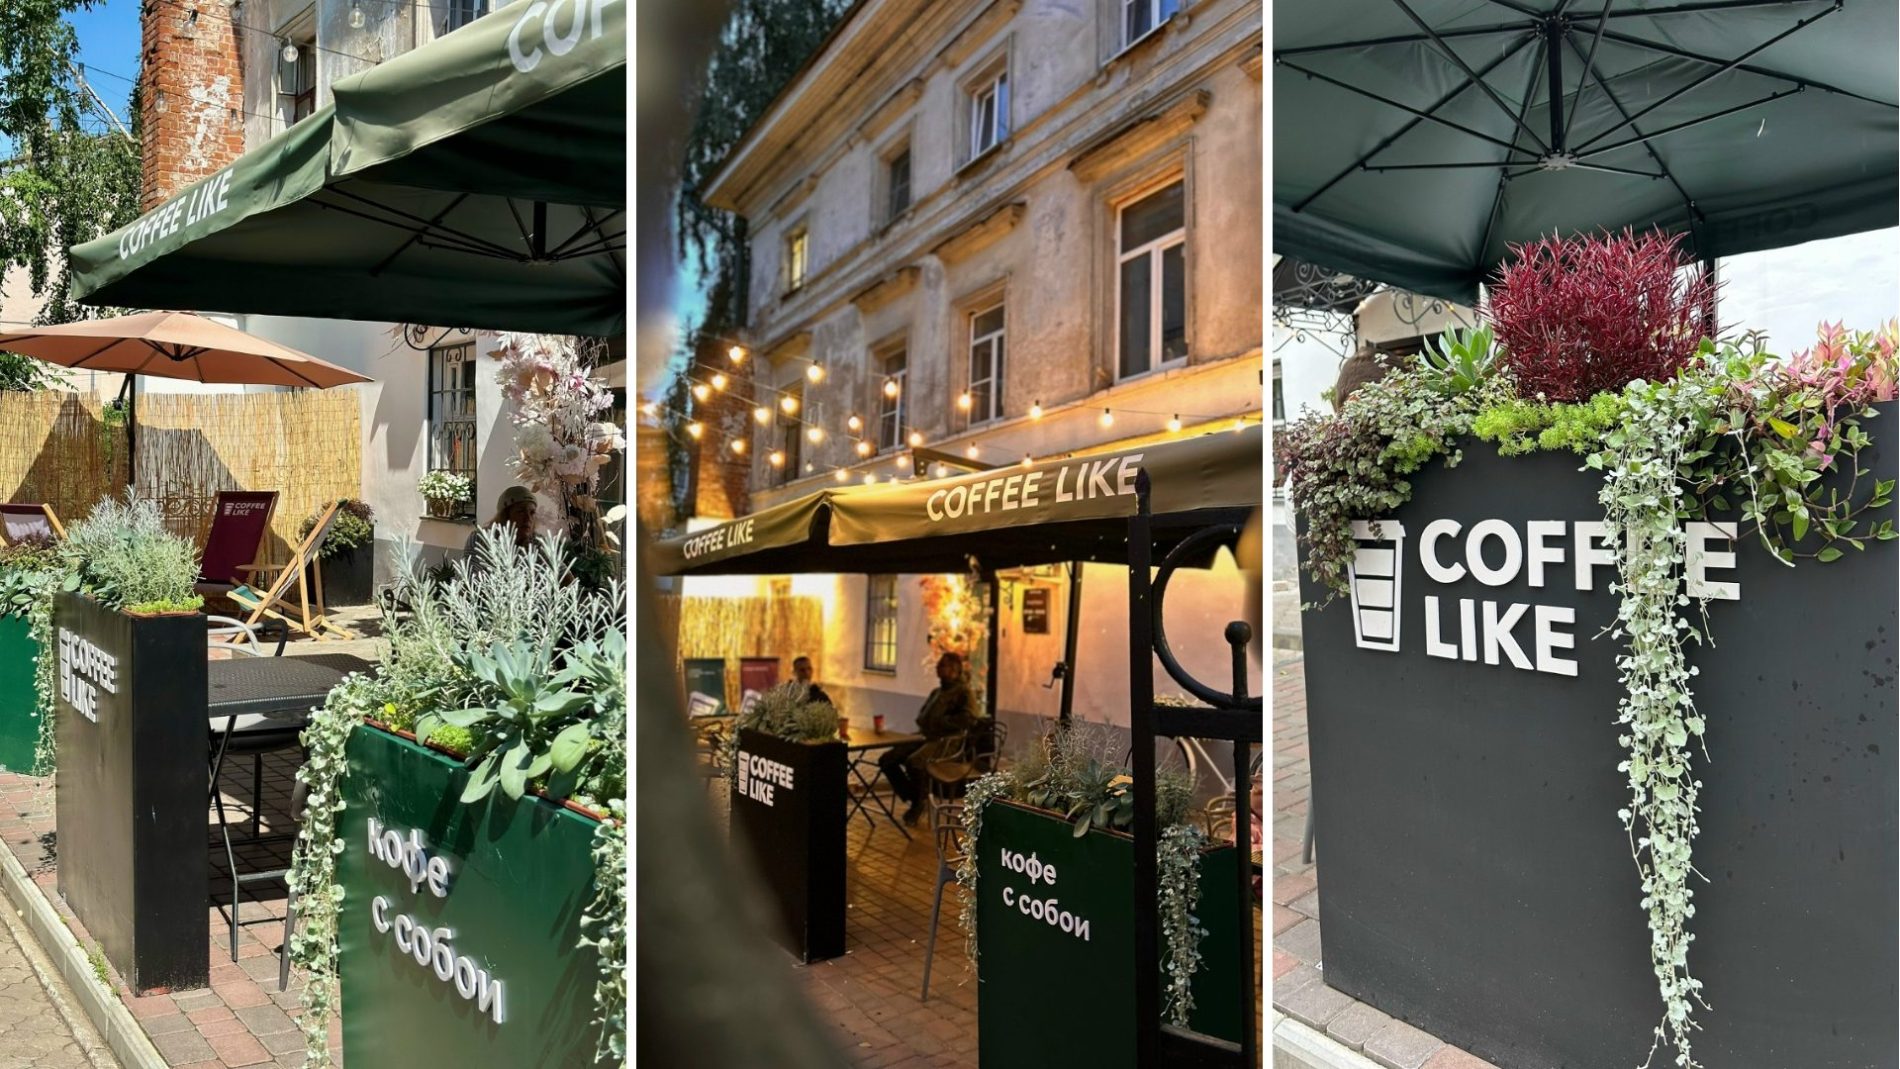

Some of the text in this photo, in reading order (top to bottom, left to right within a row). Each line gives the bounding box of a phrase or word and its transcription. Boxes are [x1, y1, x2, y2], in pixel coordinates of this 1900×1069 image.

[119, 168, 234, 260] COFFEE LIKE
[234, 502, 266, 510] COFFEE
[926, 453, 1144, 522] COFFEE LIKE
[683, 519, 755, 560] COFFEE LIKE
[1424, 595, 1578, 677] LIKE
[70, 634, 117, 694] COFFEE
[71, 673, 97, 723] LIKE
[749, 777, 775, 807] LIKE
[750, 754, 794, 790] COFFEE
[367, 817, 450, 898] кофе
[1001, 847, 1057, 886] кофе
[372, 895, 391, 934] с
[1003, 886, 1015, 907] с
